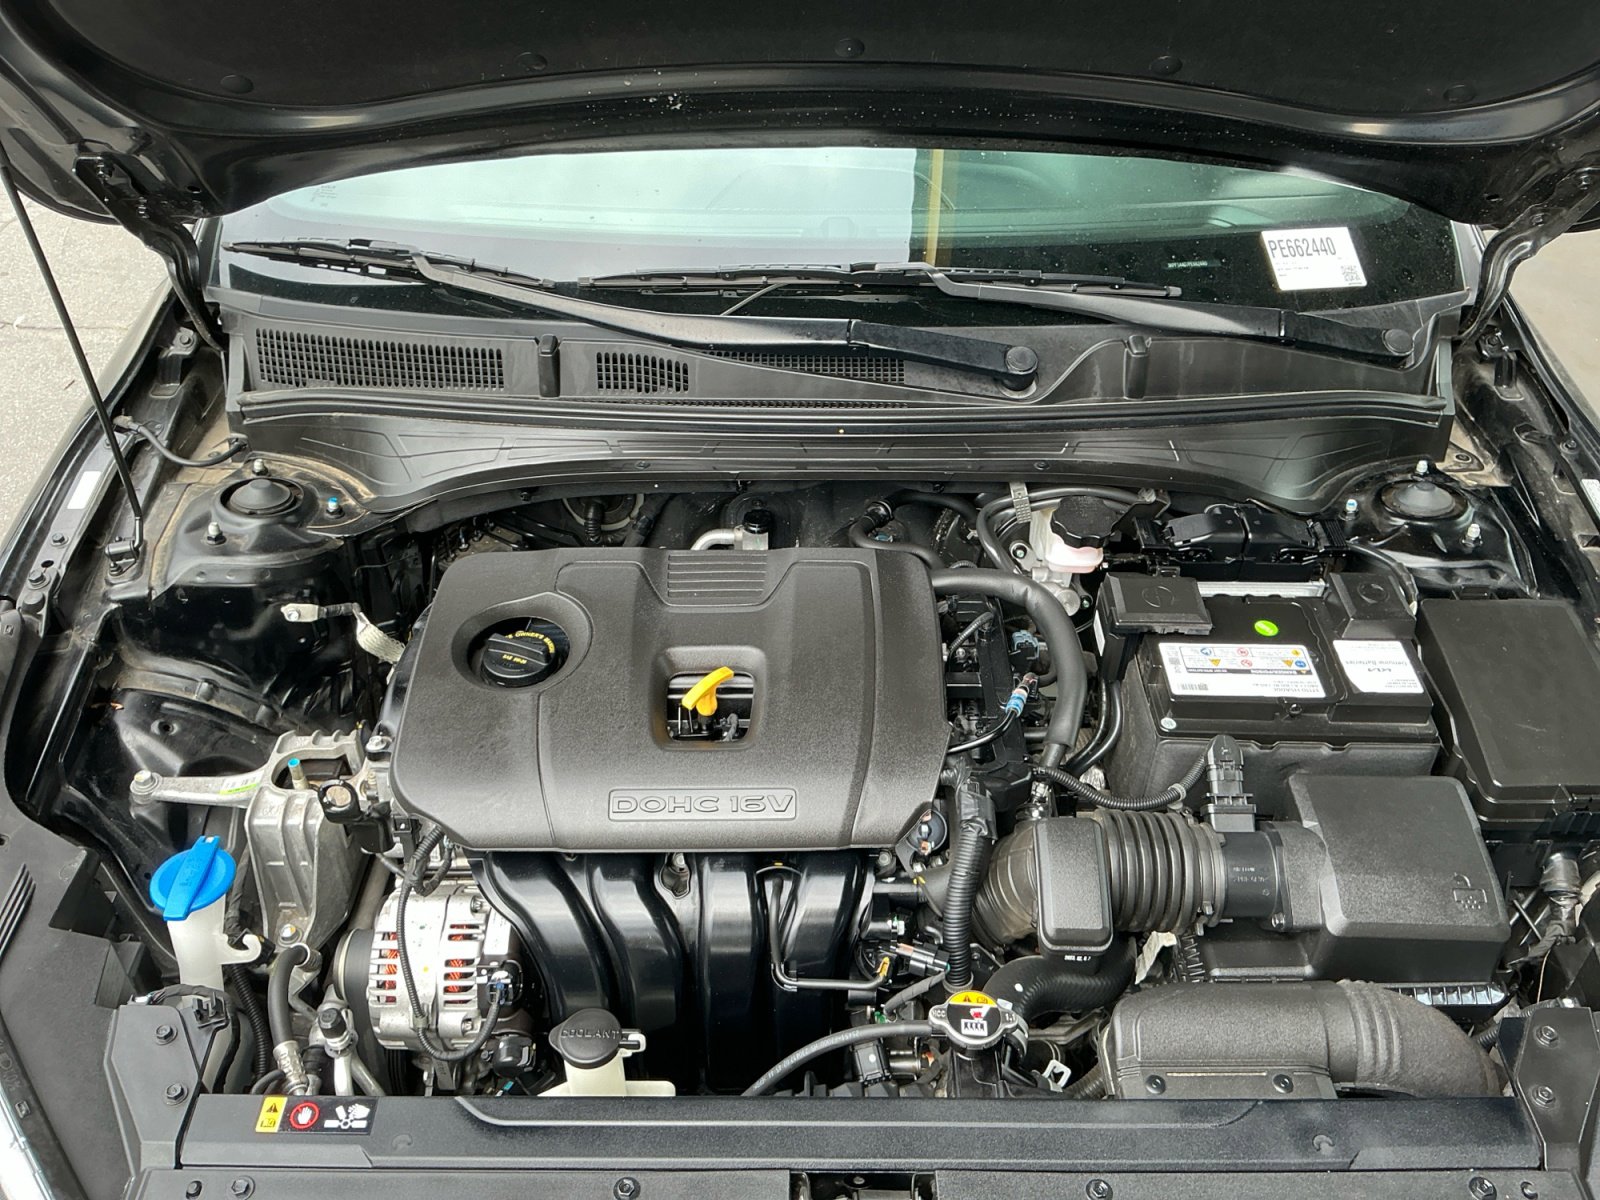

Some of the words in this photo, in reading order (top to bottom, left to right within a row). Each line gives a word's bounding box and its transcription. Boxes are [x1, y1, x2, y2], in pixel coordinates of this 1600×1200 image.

[1267, 236, 1337, 259] PE662440
[611, 795, 720, 814] DOHC
[729, 794, 794, 813] 16V
[932, 1009, 946, 1018] HCC
[560, 1029, 620, 1040] COOLANT
